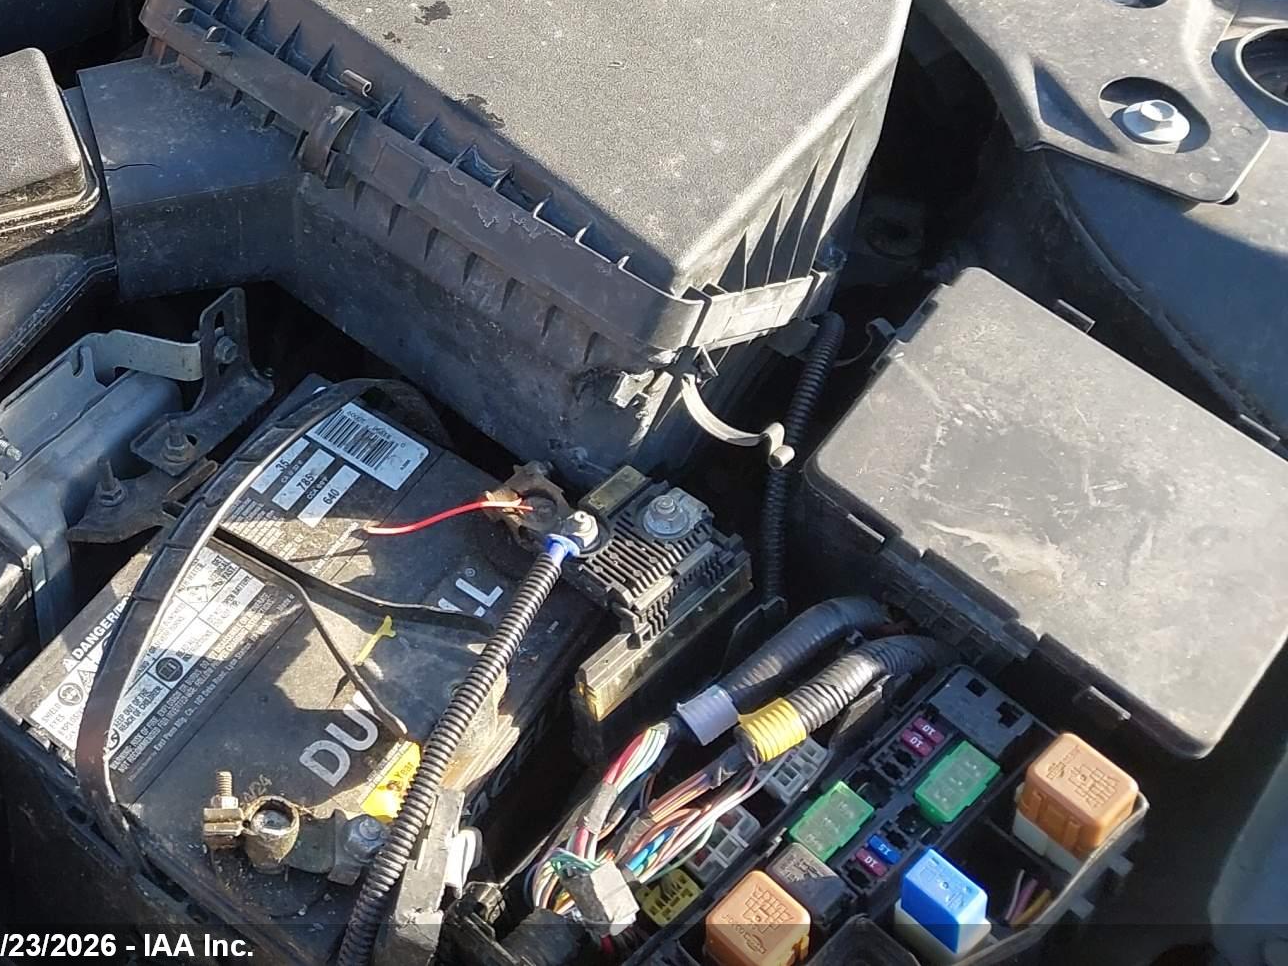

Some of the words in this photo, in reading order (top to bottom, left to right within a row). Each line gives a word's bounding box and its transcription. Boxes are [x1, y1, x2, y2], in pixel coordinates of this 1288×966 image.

[274, 457, 291, 472] 35
[295, 473, 315, 492] 785
[321, 487, 341, 505] 640
[210, 554, 224, 567] GET
[220, 562, 238, 580] FAST.
[230, 572, 253, 596] BATTERY.
[111, 712, 126, 728] KEEP
[122, 703, 135, 716] OUT
[131, 695, 142, 706] OF
[137, 687, 149, 699] THE
[117, 713, 136, 733] REACH
[131, 708, 141, 717] OF
[136, 684, 163, 712] CHILDREN.
[116, 758, 130, 773] NOT
[125, 724, 161, 763] RECOMMENDED
[156, 715, 170, 729] FOR
[129, 731, 144, 747] RISK
[139, 725, 150, 736] OF
[151, 736, 167, 752] East
[161, 723, 179, 741] Penn
